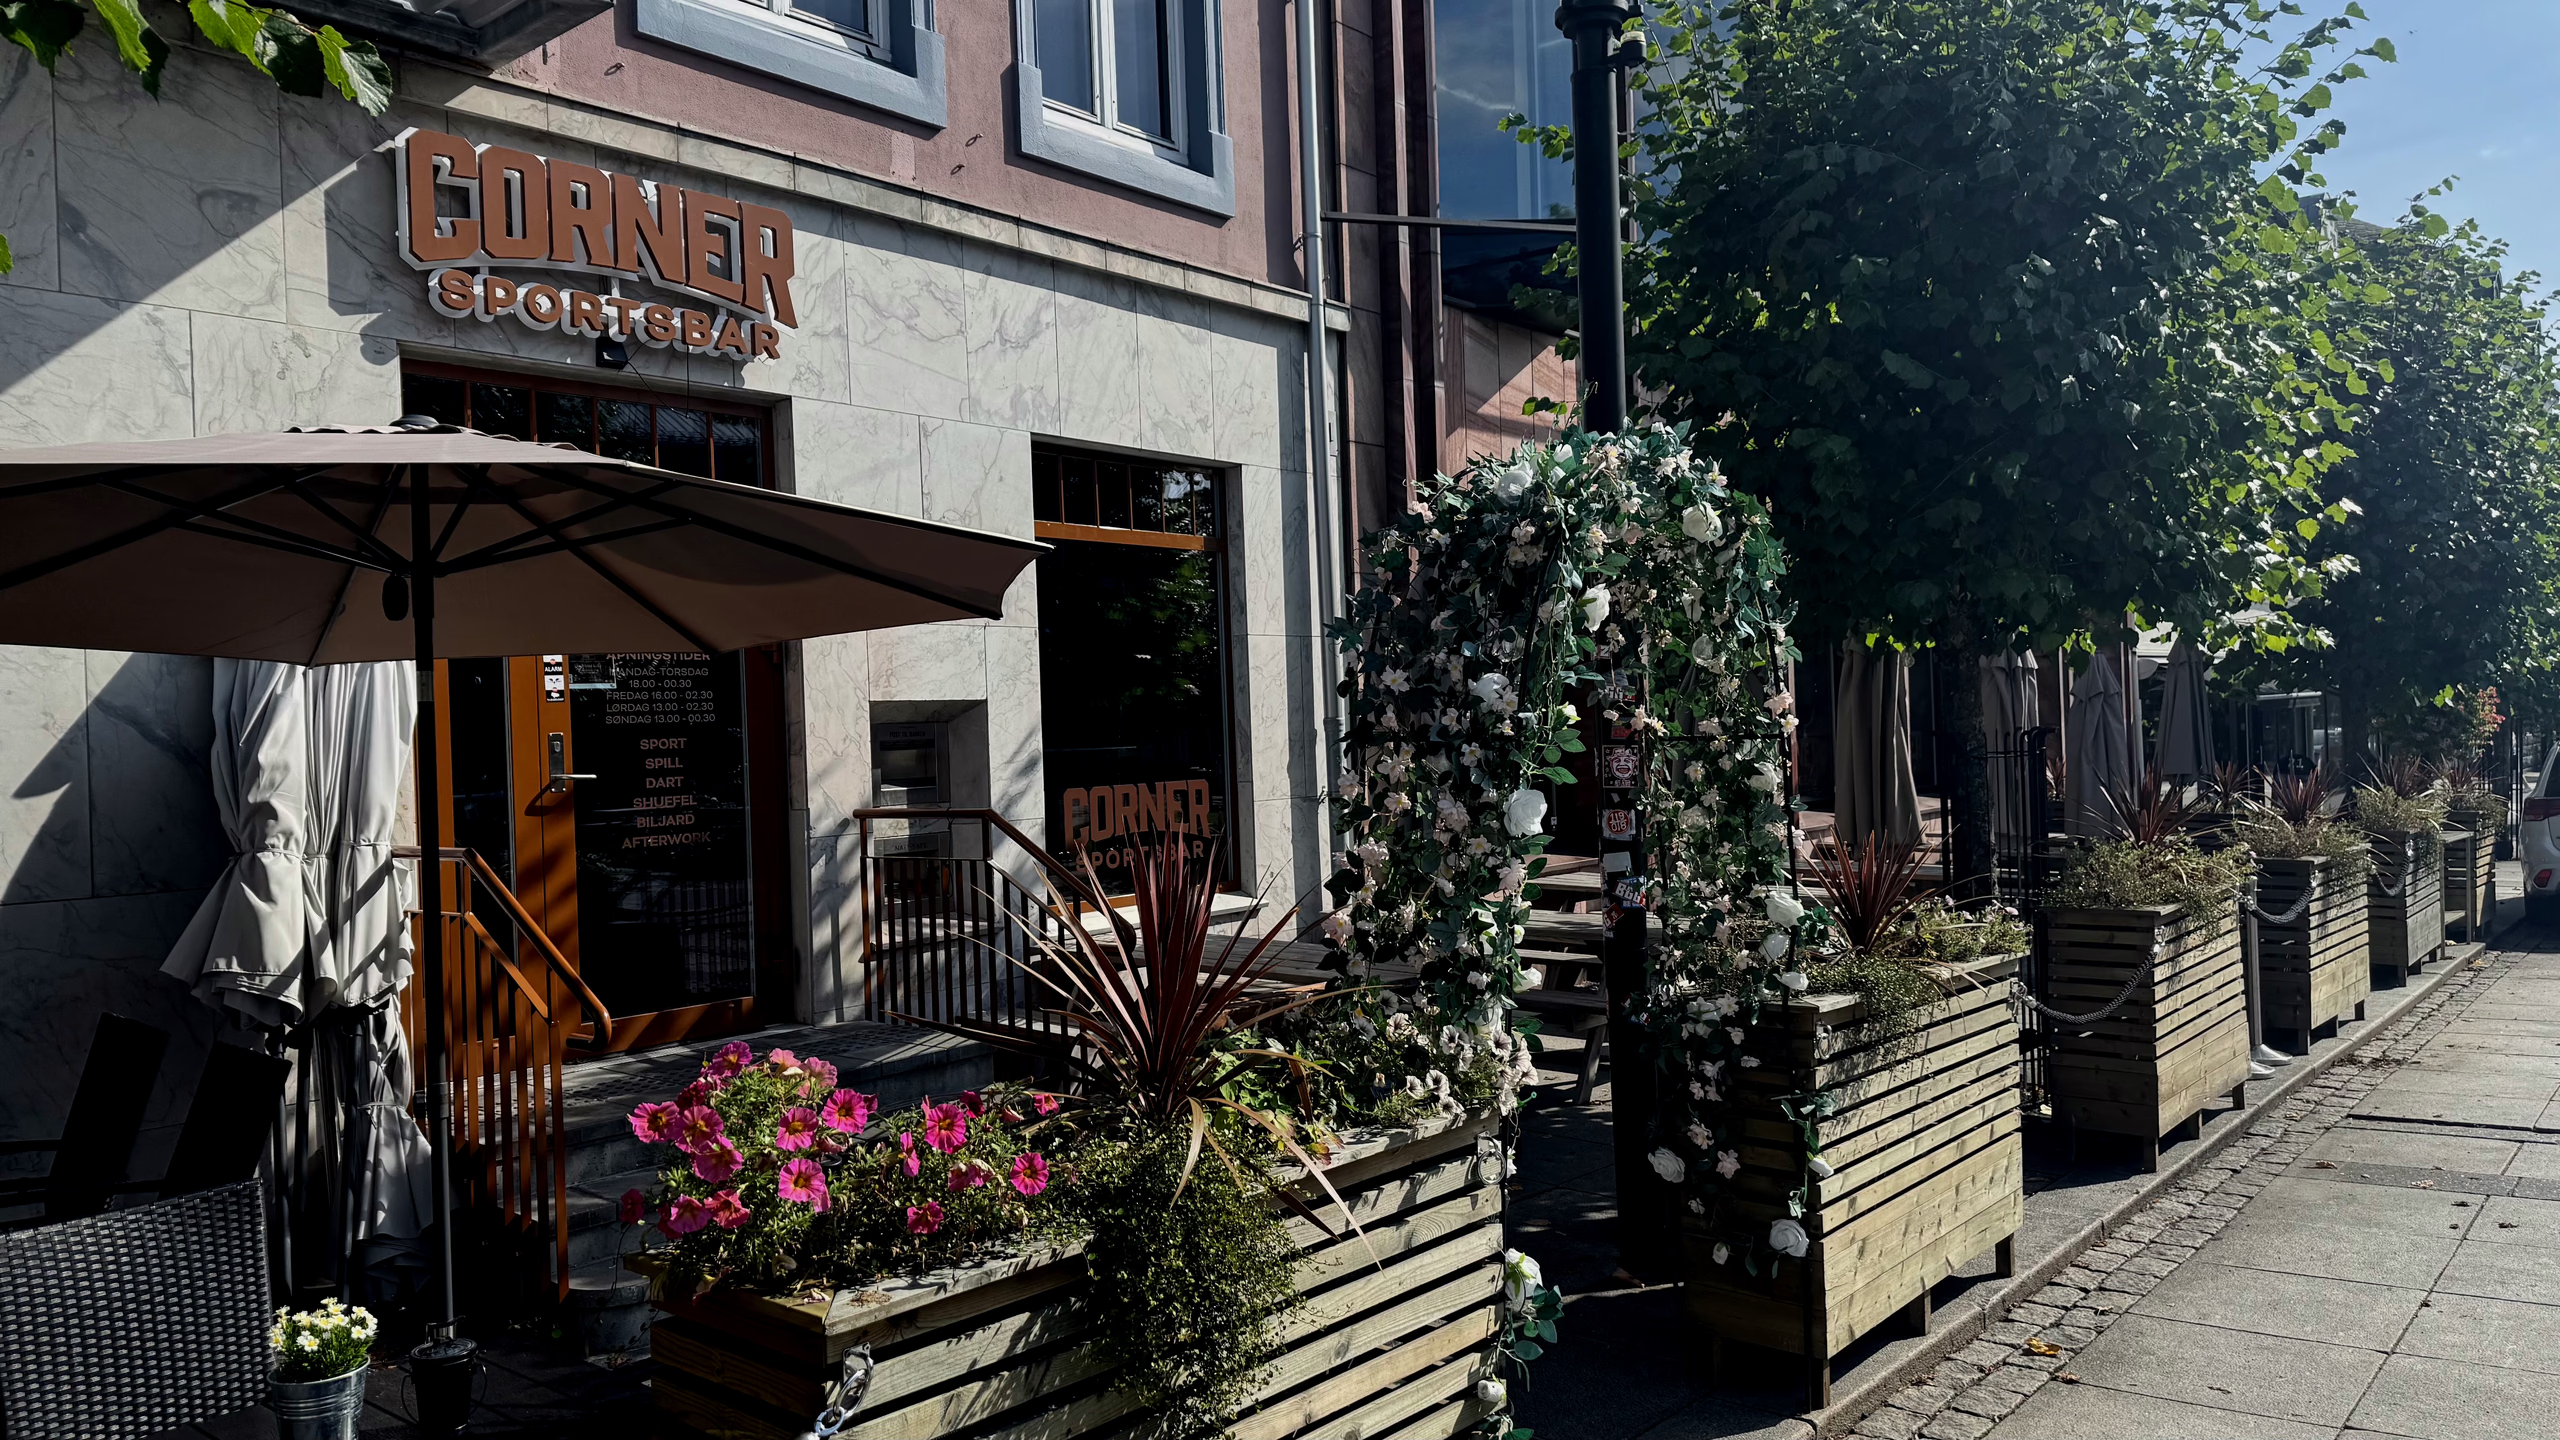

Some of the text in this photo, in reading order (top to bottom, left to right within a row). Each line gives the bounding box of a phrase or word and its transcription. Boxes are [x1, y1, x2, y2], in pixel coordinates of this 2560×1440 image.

[405, 127, 799, 329] CORNER
[436, 268, 781, 360] SPORTSBAR
[608, 667, 709, 677] MANDAG-TORSDAG
[628, 679, 656, 688] 18.00
[663, 679, 692, 688] 00.30
[606, 691, 649, 700] FREDAG
[651, 691, 677, 700] 16.00
[685, 690, 713, 699] 02.30
[606, 702, 650, 712] LØRDAG
[652, 702, 678, 711] 13.00
[686, 702, 714, 711] 02.30
[605, 714, 652, 724] SØNDAG
[654, 714, 680, 723] 13.00
[688, 713, 716, 723] 00.30
[639, 737, 687, 750] SPORT
[645, 757, 683, 769] SPILL
[645, 776, 684, 789] DART
[633, 795, 697, 809] SHUFFEL
[636, 813, 695, 829] BILJARD
[1063, 779, 1212, 850] CORNER
[621, 831, 711, 849] AFTERWORK
